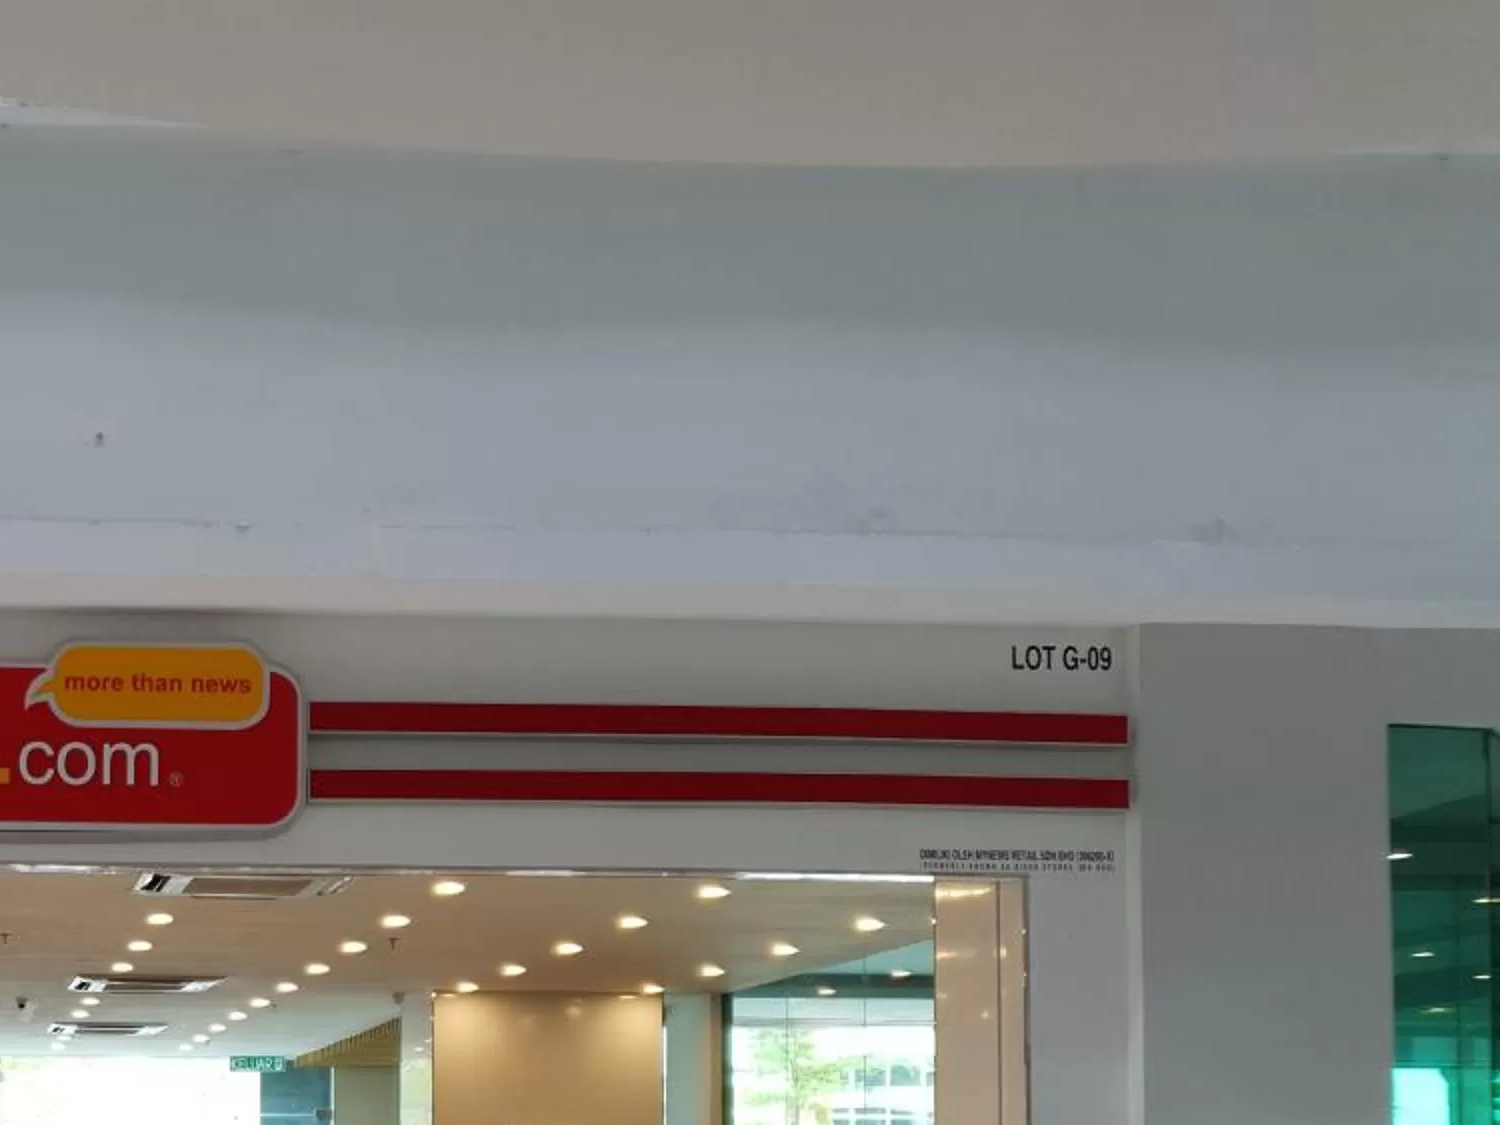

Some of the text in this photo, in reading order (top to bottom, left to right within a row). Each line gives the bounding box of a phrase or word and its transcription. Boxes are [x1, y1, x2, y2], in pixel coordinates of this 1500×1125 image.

[1011, 645, 1113, 671] LOT G-09
[64, 672, 252, 694] more than news
